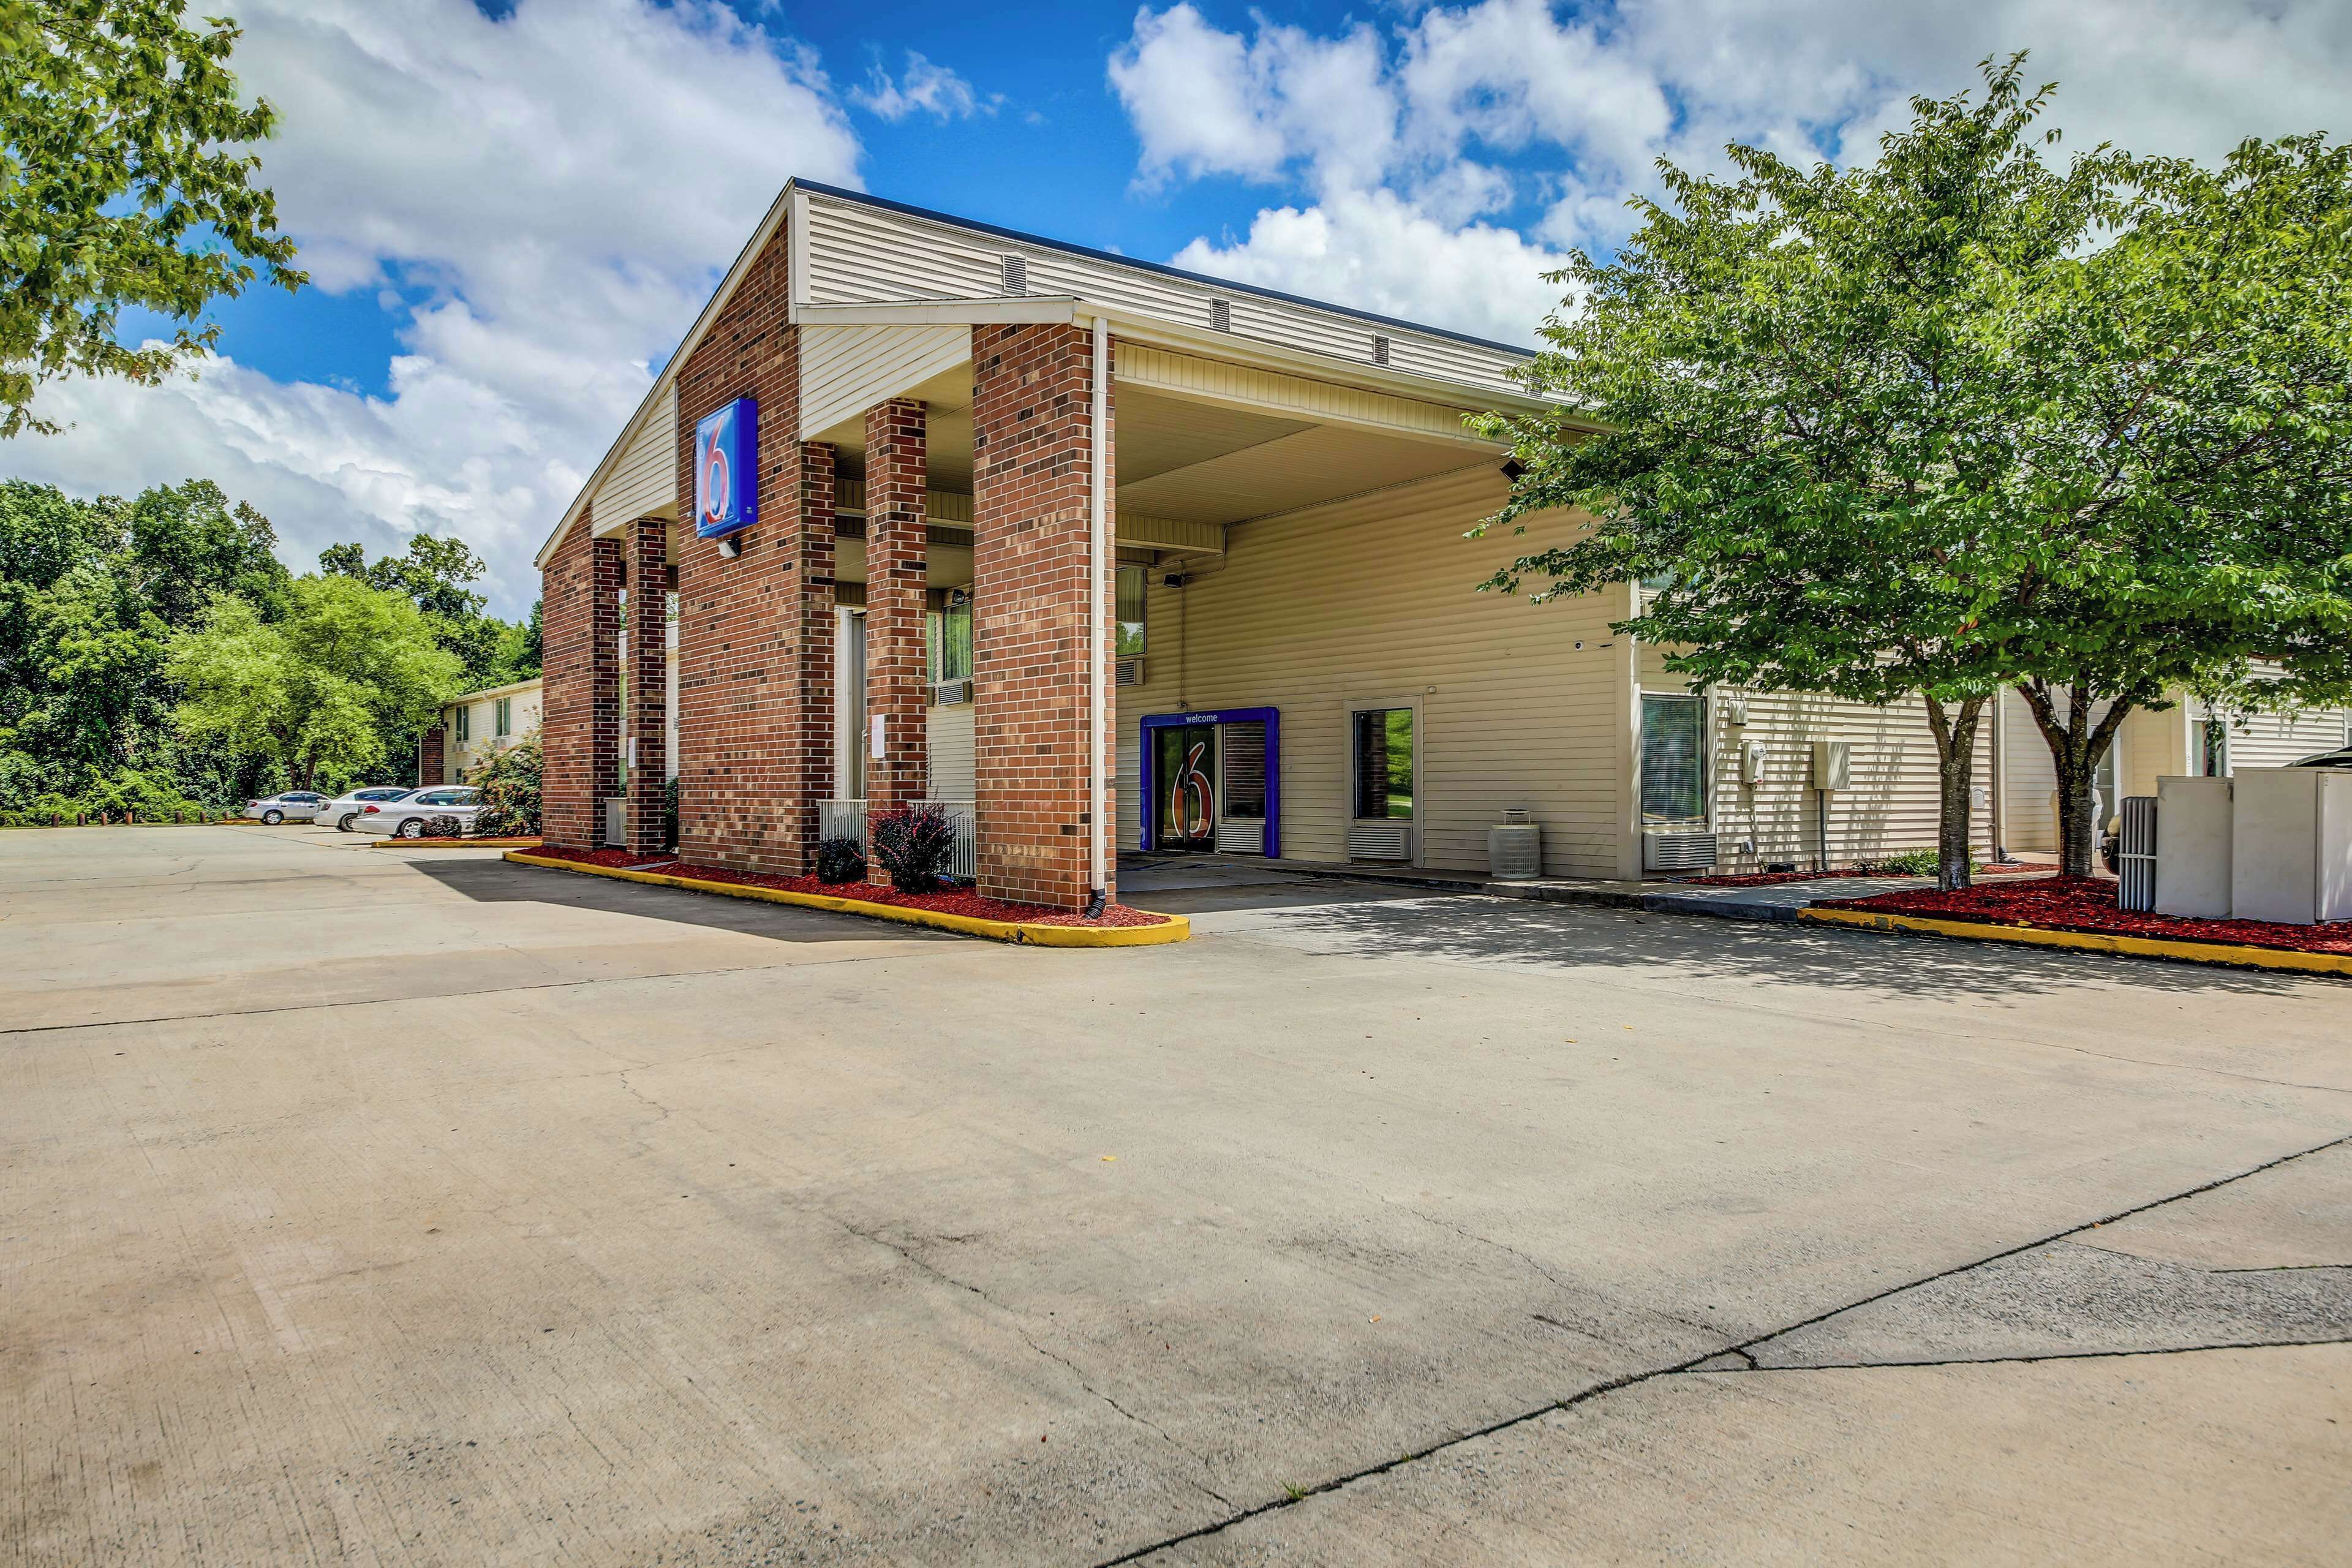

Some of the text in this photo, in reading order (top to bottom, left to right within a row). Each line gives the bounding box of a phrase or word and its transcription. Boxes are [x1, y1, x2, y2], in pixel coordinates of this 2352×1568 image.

[703, 415, 729, 525] 6
[1186, 714, 1218, 723] welcome
[1172, 741, 1213, 837] 6
